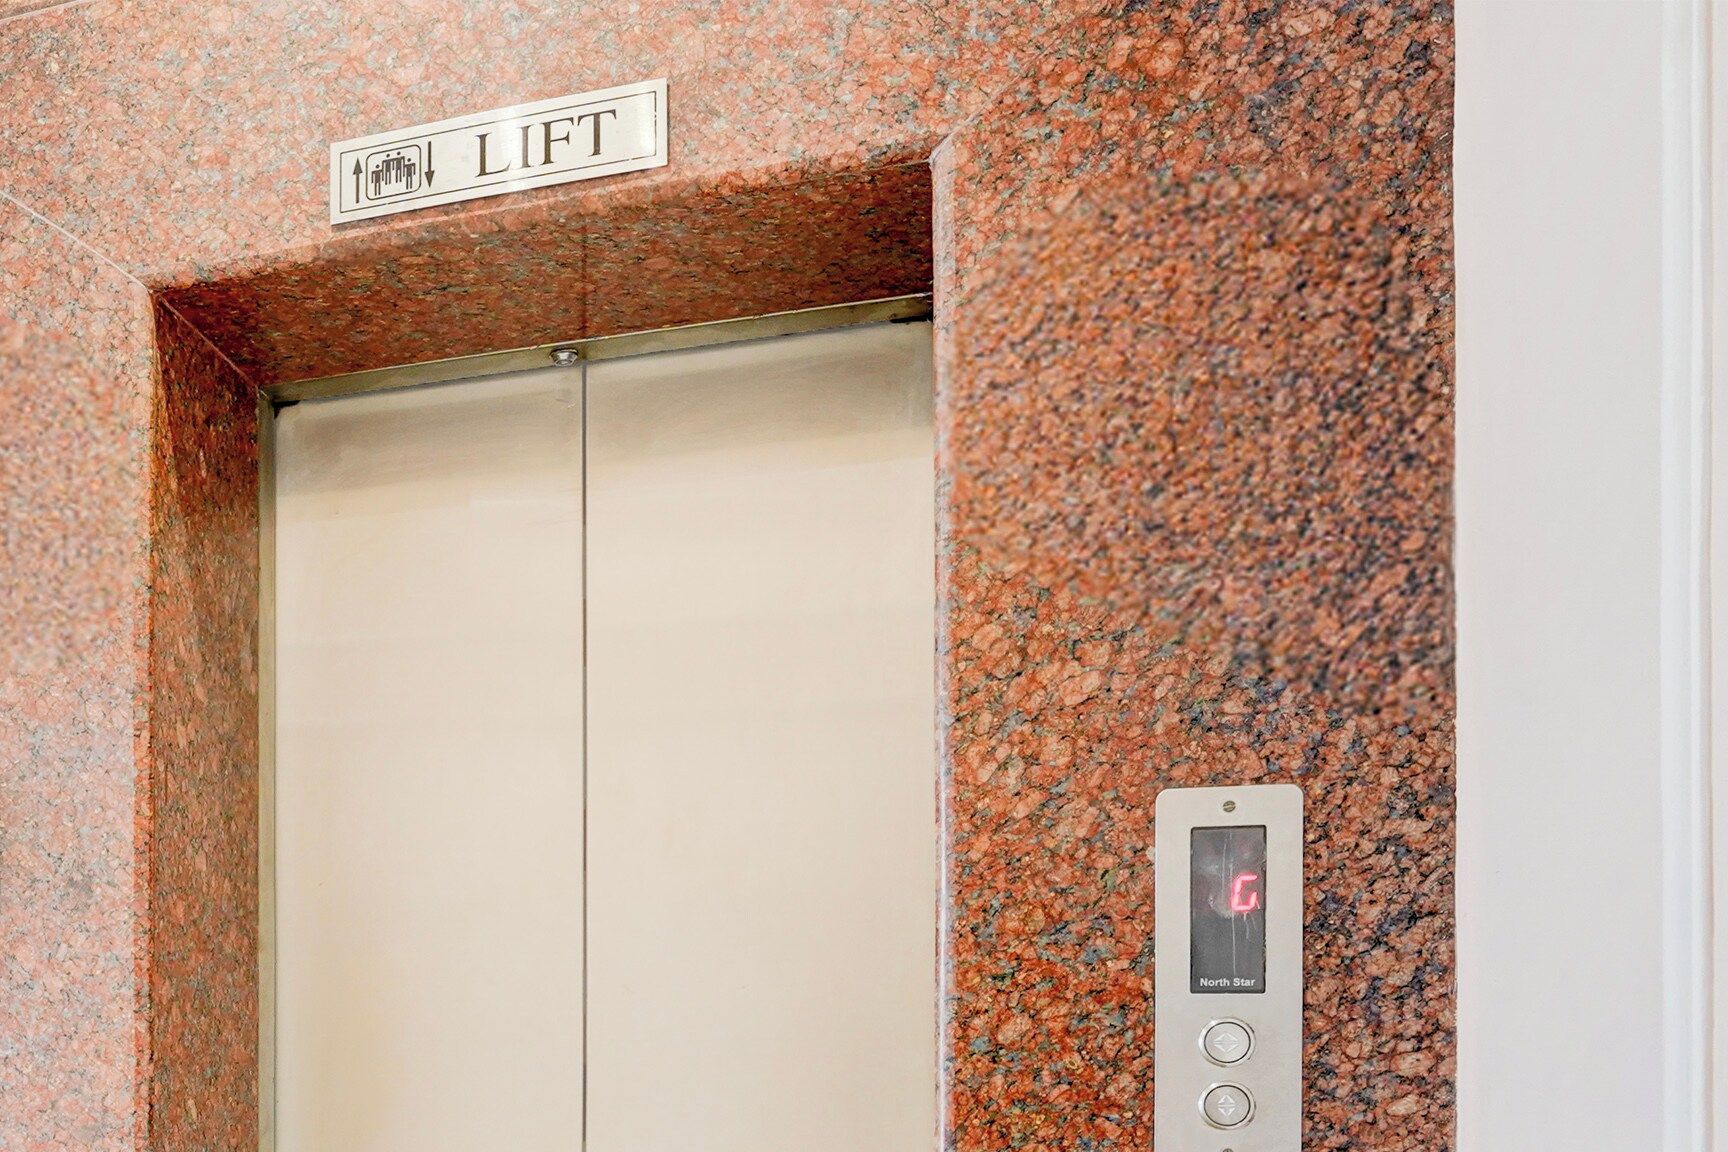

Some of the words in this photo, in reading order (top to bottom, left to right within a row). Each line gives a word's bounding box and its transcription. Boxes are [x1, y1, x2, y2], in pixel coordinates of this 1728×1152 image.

[474, 108, 617, 178] LIFT
[1231, 874, 1258, 911] G
[1200, 977, 1230, 987] North
[1233, 977, 1256, 987] Star
